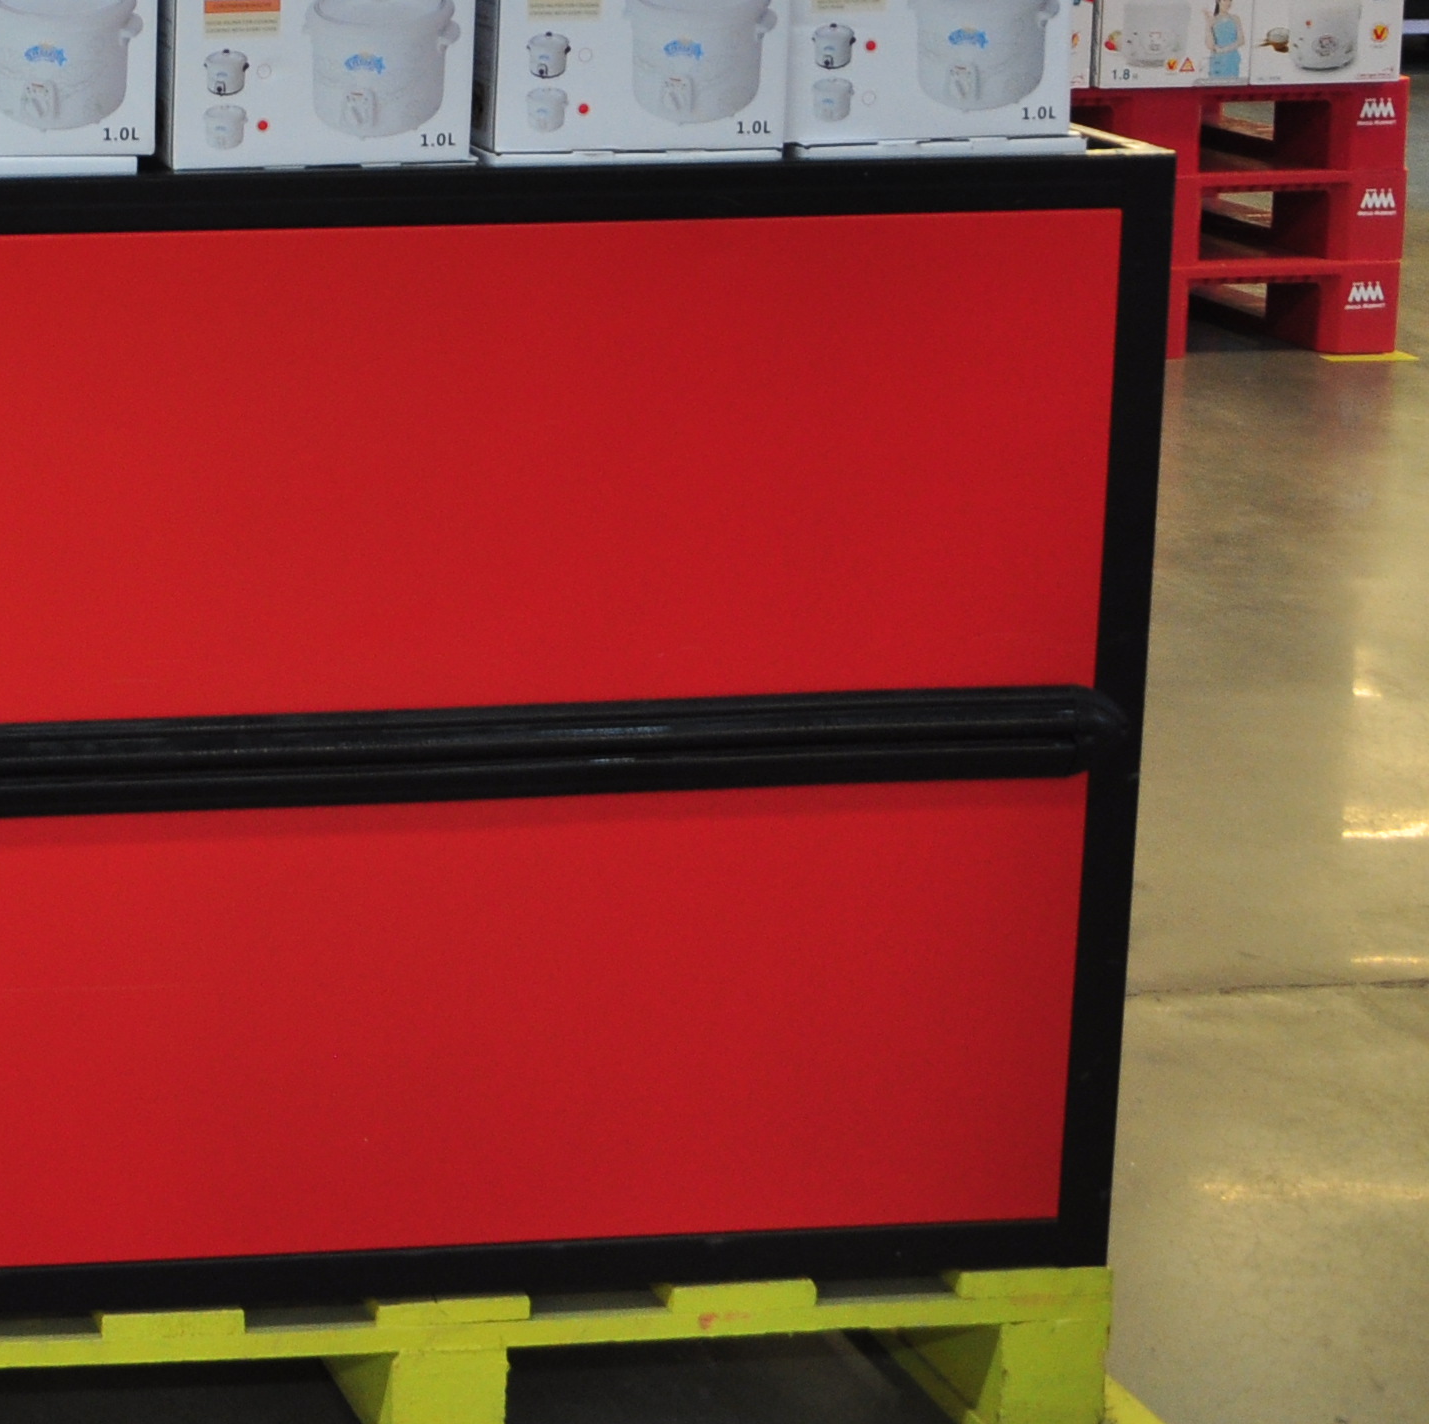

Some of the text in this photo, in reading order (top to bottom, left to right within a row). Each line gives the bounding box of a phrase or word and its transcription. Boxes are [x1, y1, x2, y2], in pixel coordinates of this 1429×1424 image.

[1111, 69, 1131, 81] 1.8
[1021, 106, 1057, 120] 1.0L
[102, 127, 140, 142] 1.0L
[736, 120, 772, 135] 1.0L
[419, 132, 456, 148] 1.0L
